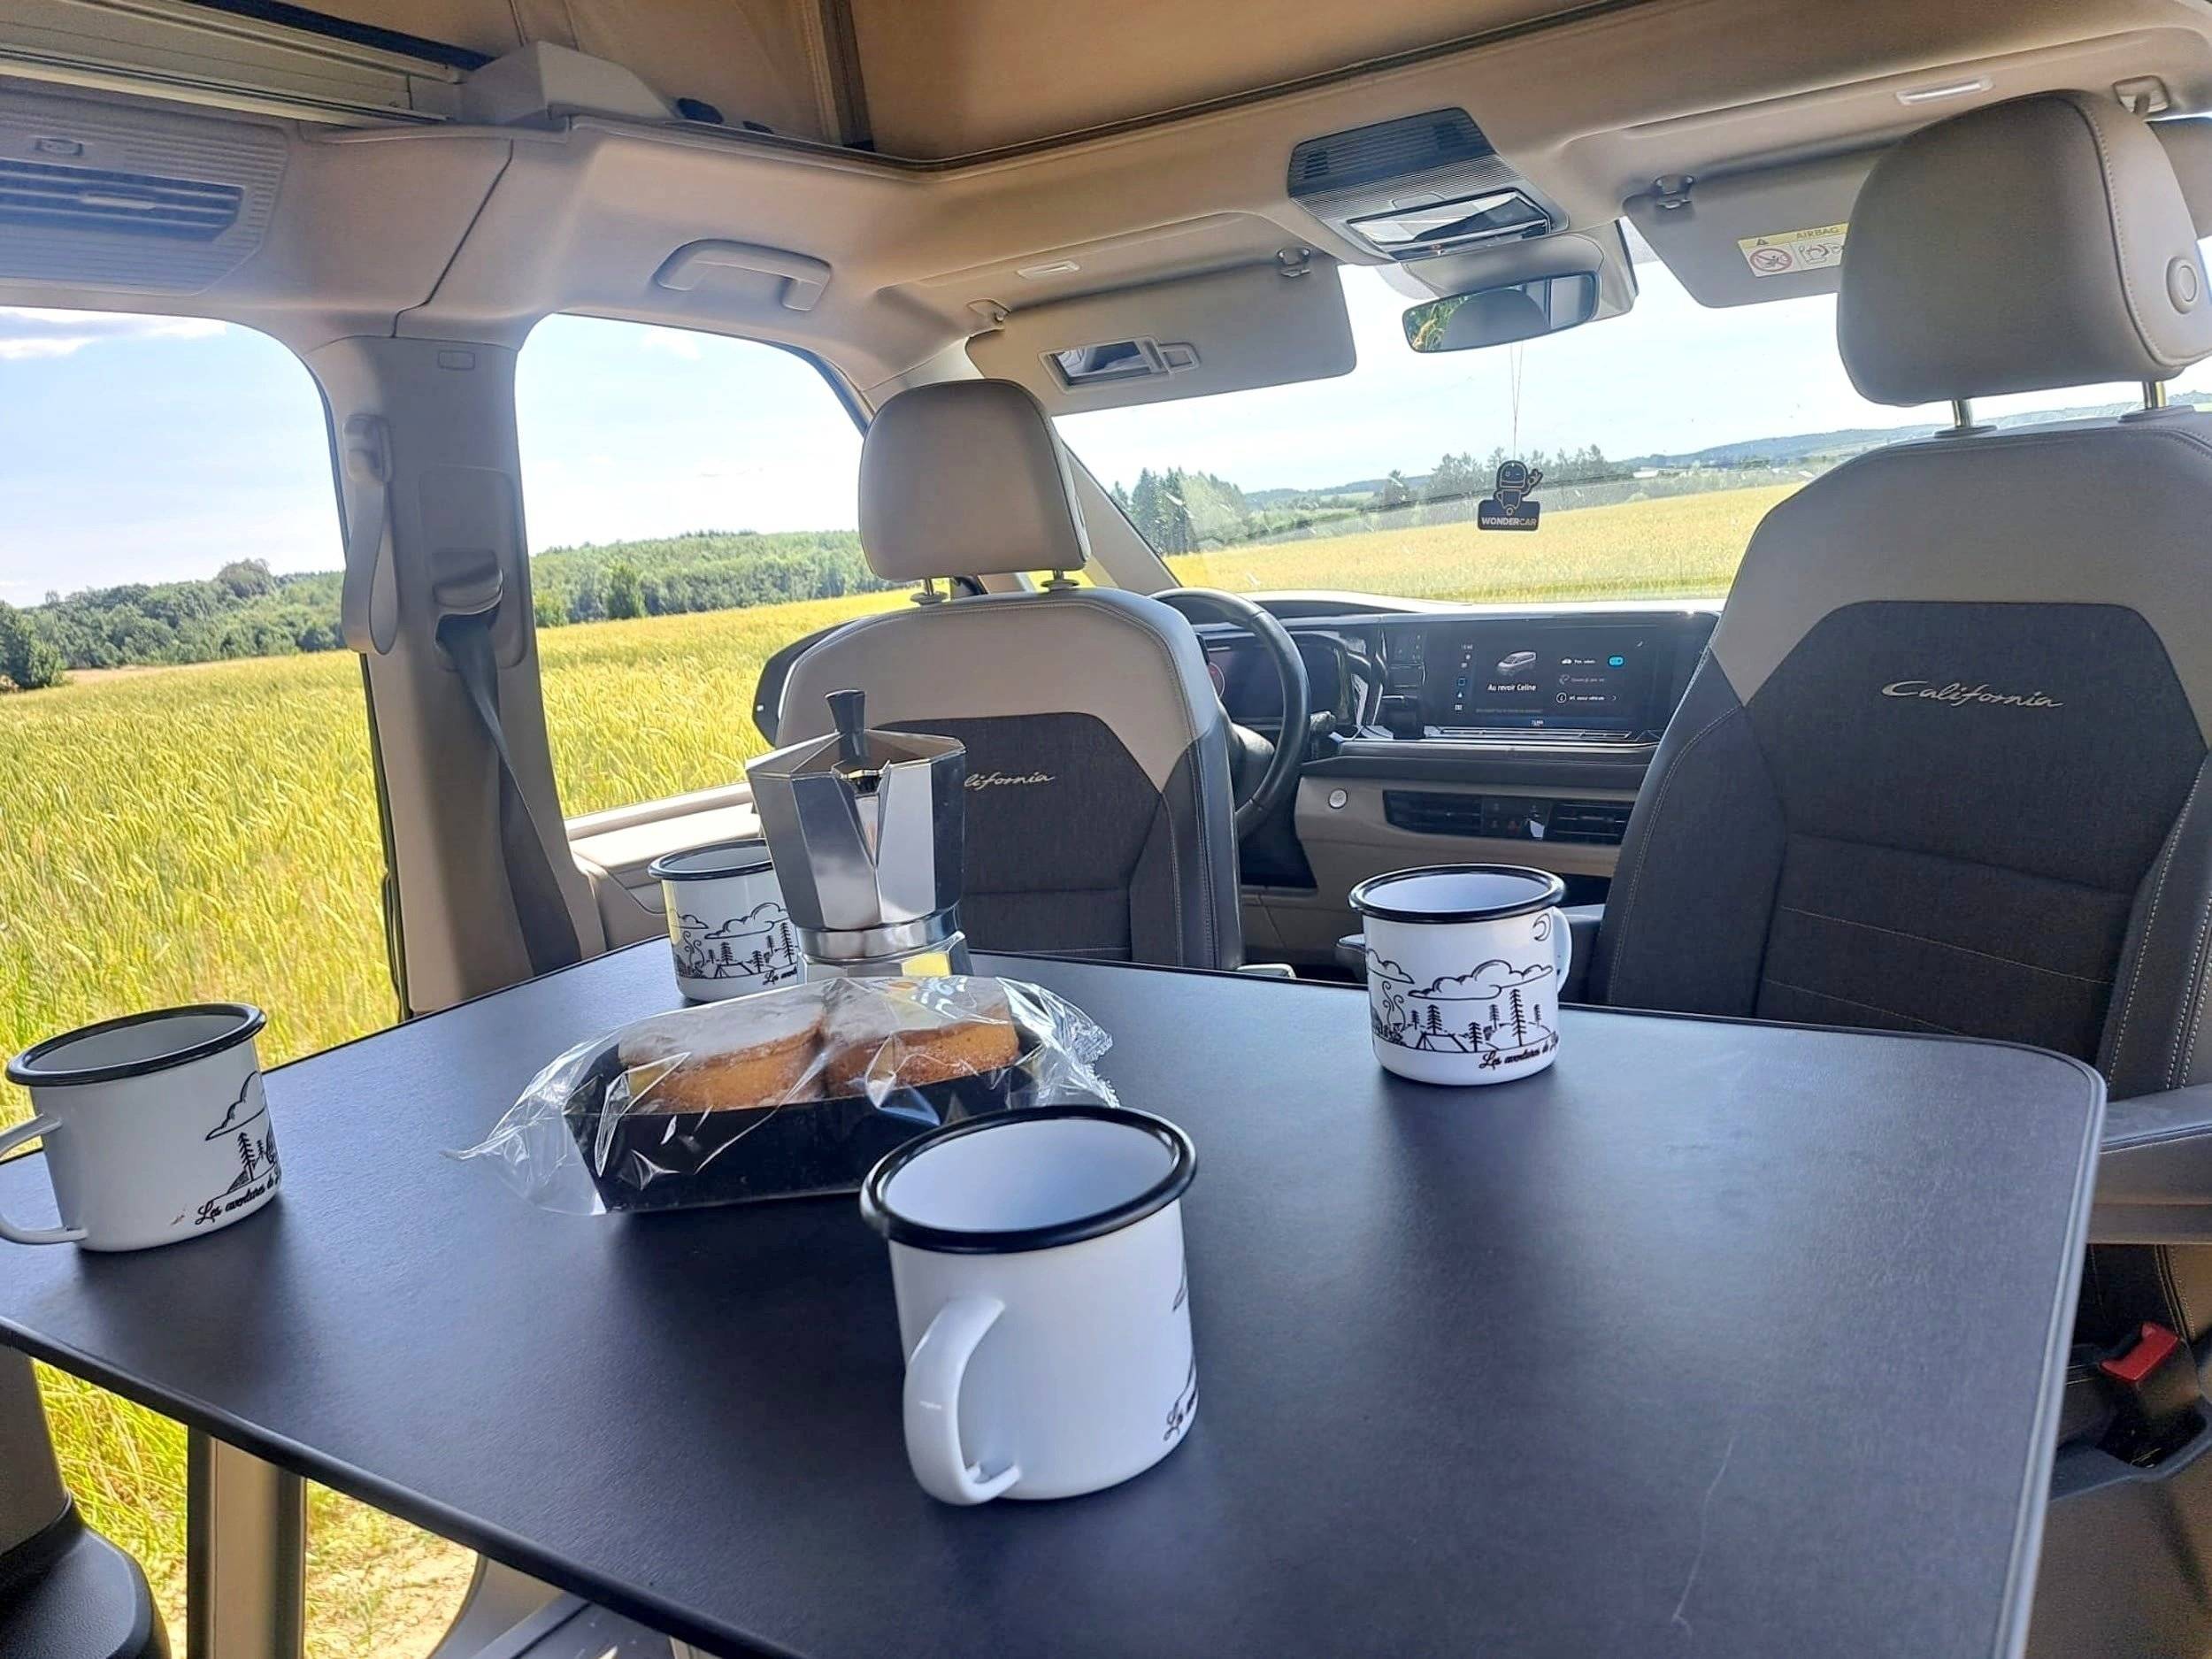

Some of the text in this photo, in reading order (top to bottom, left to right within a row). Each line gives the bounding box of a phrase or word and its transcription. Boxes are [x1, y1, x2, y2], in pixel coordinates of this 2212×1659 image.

[1796, 227, 1840, 240] AIRBAG
[1481, 517, 1537, 526] WONDERCAR
[1881, 680, 2064, 708] California
[964, 772, 1056, 791] lifornia
